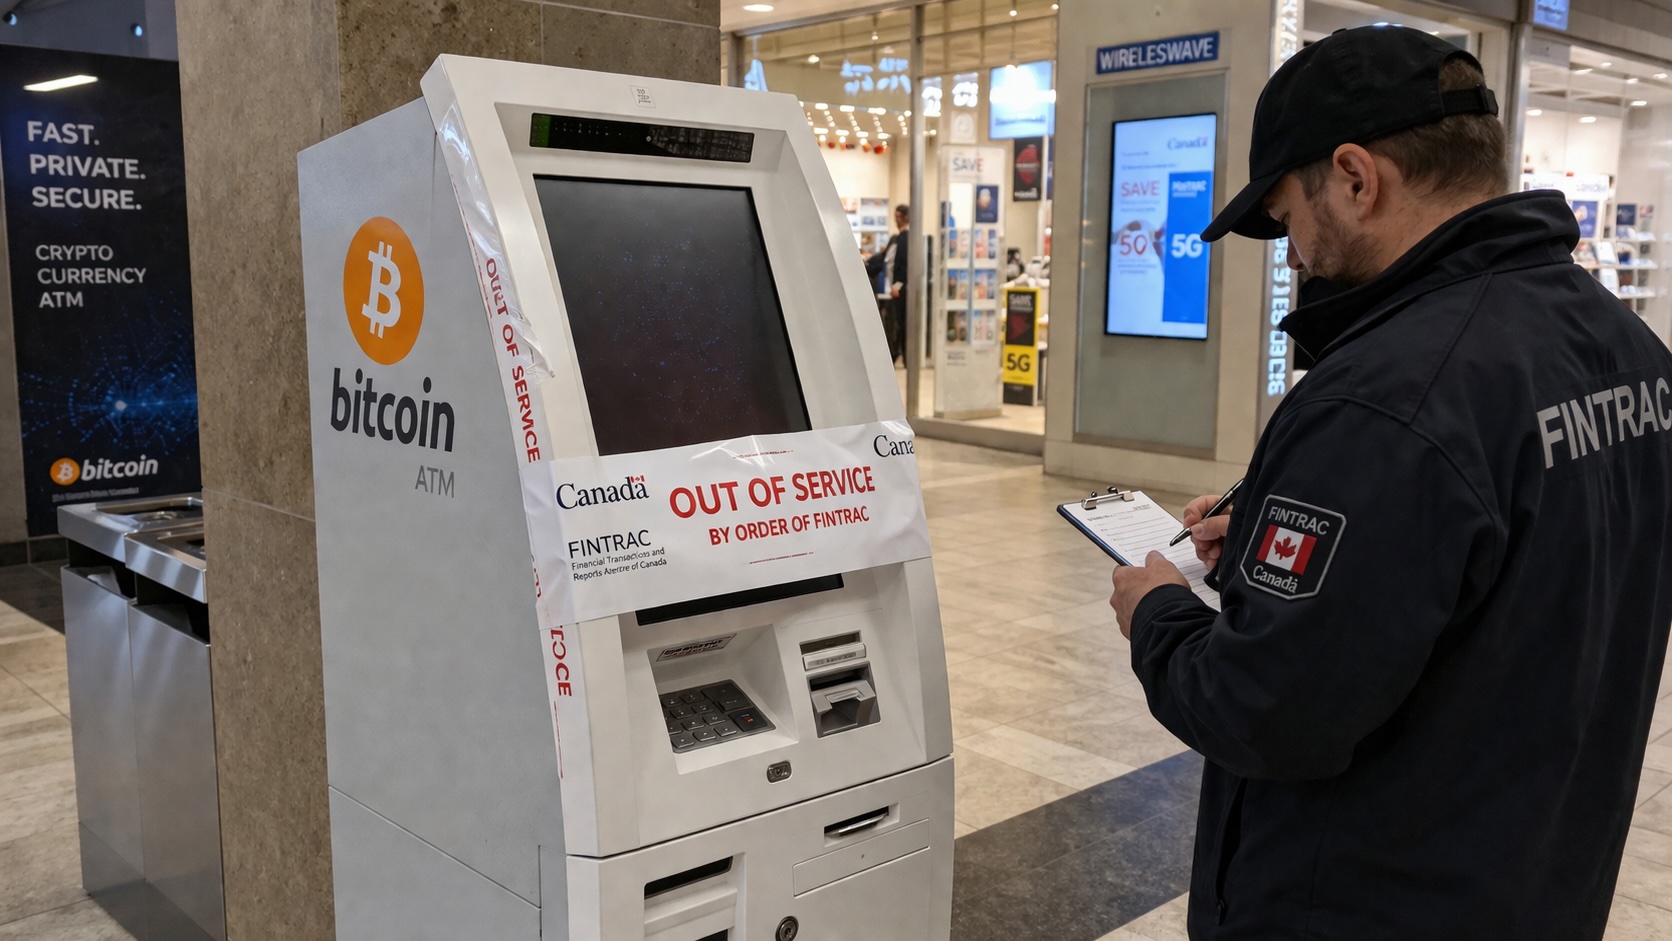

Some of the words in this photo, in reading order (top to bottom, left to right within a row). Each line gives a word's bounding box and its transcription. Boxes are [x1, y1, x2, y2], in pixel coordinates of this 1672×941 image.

[1099, 36, 1214, 72] WIRELESWAVE
[27, 121, 100, 146] FAST.
[29, 154, 146, 180] PRIVATE.
[952, 157, 985, 173] SAVE
[32, 187, 142, 211] SECURE.
[1120, 181, 1160, 198] SAVE
[35, 244, 114, 262] CRYPTO
[1119, 234, 1148, 257] 50
[1171, 233, 1204, 259] 5G
[37, 267, 147, 285] CURRENCY
[39, 290, 84, 309] ATM
[1006, 353, 1031, 373] 5G
[502, 324, 520, 358] OF
[512, 365, 542, 464] SERVICE
[330, 367, 455, 453] bitcoin
[1536, 377, 1672, 469] FINTRAC
[81, 454, 159, 481] bitcoin
[414, 465, 456, 498] ATM
[669, 480, 739, 519] OUT
[748, 475, 787, 508] OF
[792, 465, 875, 502] SERVICE
[708, 525, 729, 546] BY
[734, 517, 790, 542] ORDER
[791, 514, 810, 533] OF
[813, 505, 870, 529] FINTRAC
[1268, 506, 1330, 535] FINTRAC
[568, 529, 652, 559] FINTRAC
[571, 557, 605, 571] Financial
[652, 547, 665, 557] and
[640, 557, 667, 569] Canada
